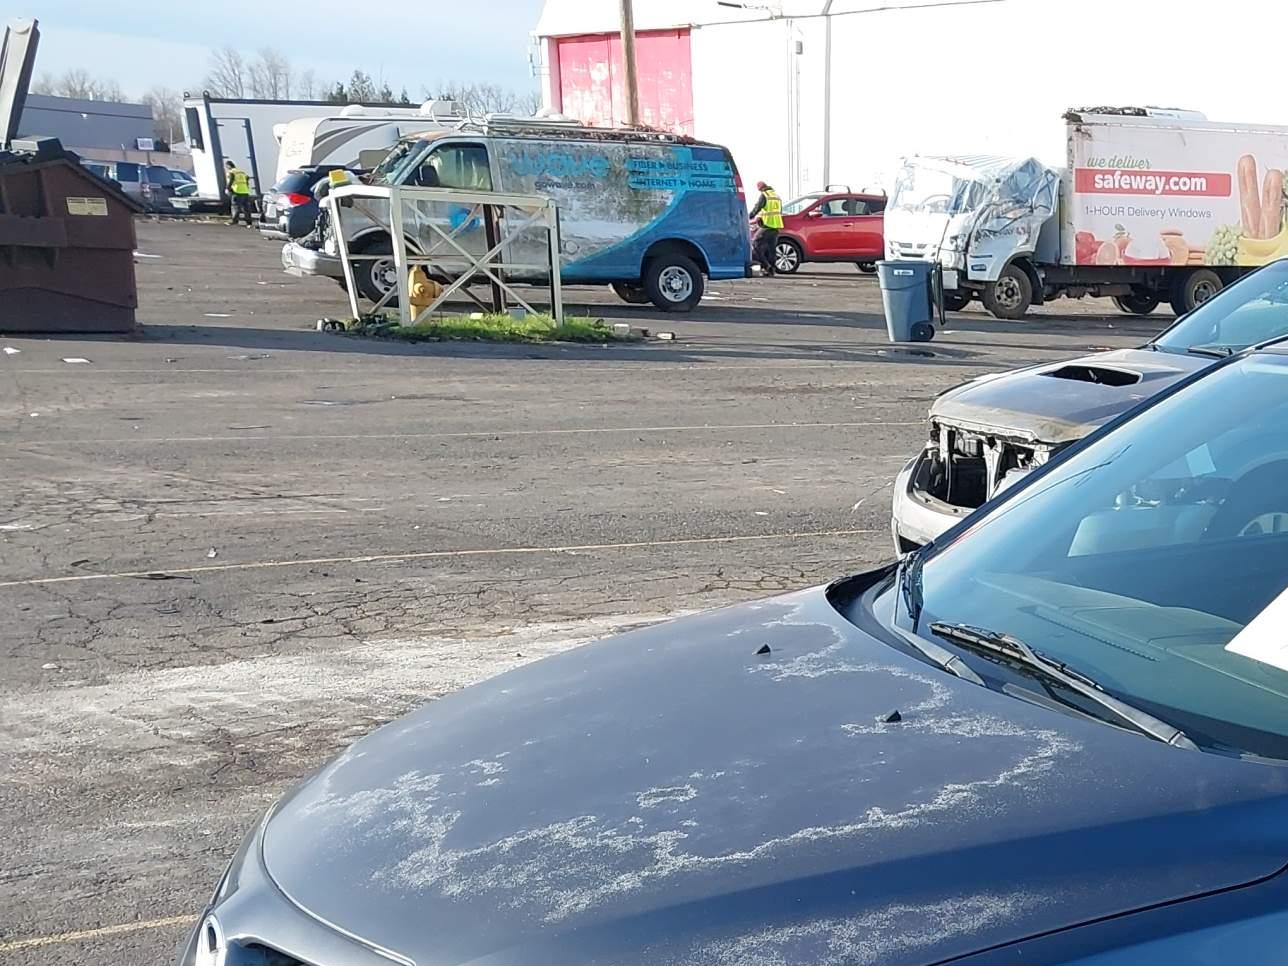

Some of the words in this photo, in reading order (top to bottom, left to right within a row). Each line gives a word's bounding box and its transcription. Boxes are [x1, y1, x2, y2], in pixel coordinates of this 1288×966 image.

[1087, 157, 1107, 168] we
[1108, 155, 1151, 170] deliver
[1094, 171, 1207, 194] safeway.com
[1085, 206, 1124, 217] 1-HOUR
[1127, 206, 1166, 219] Delivery
[1169, 208, 1212, 218] Windows
